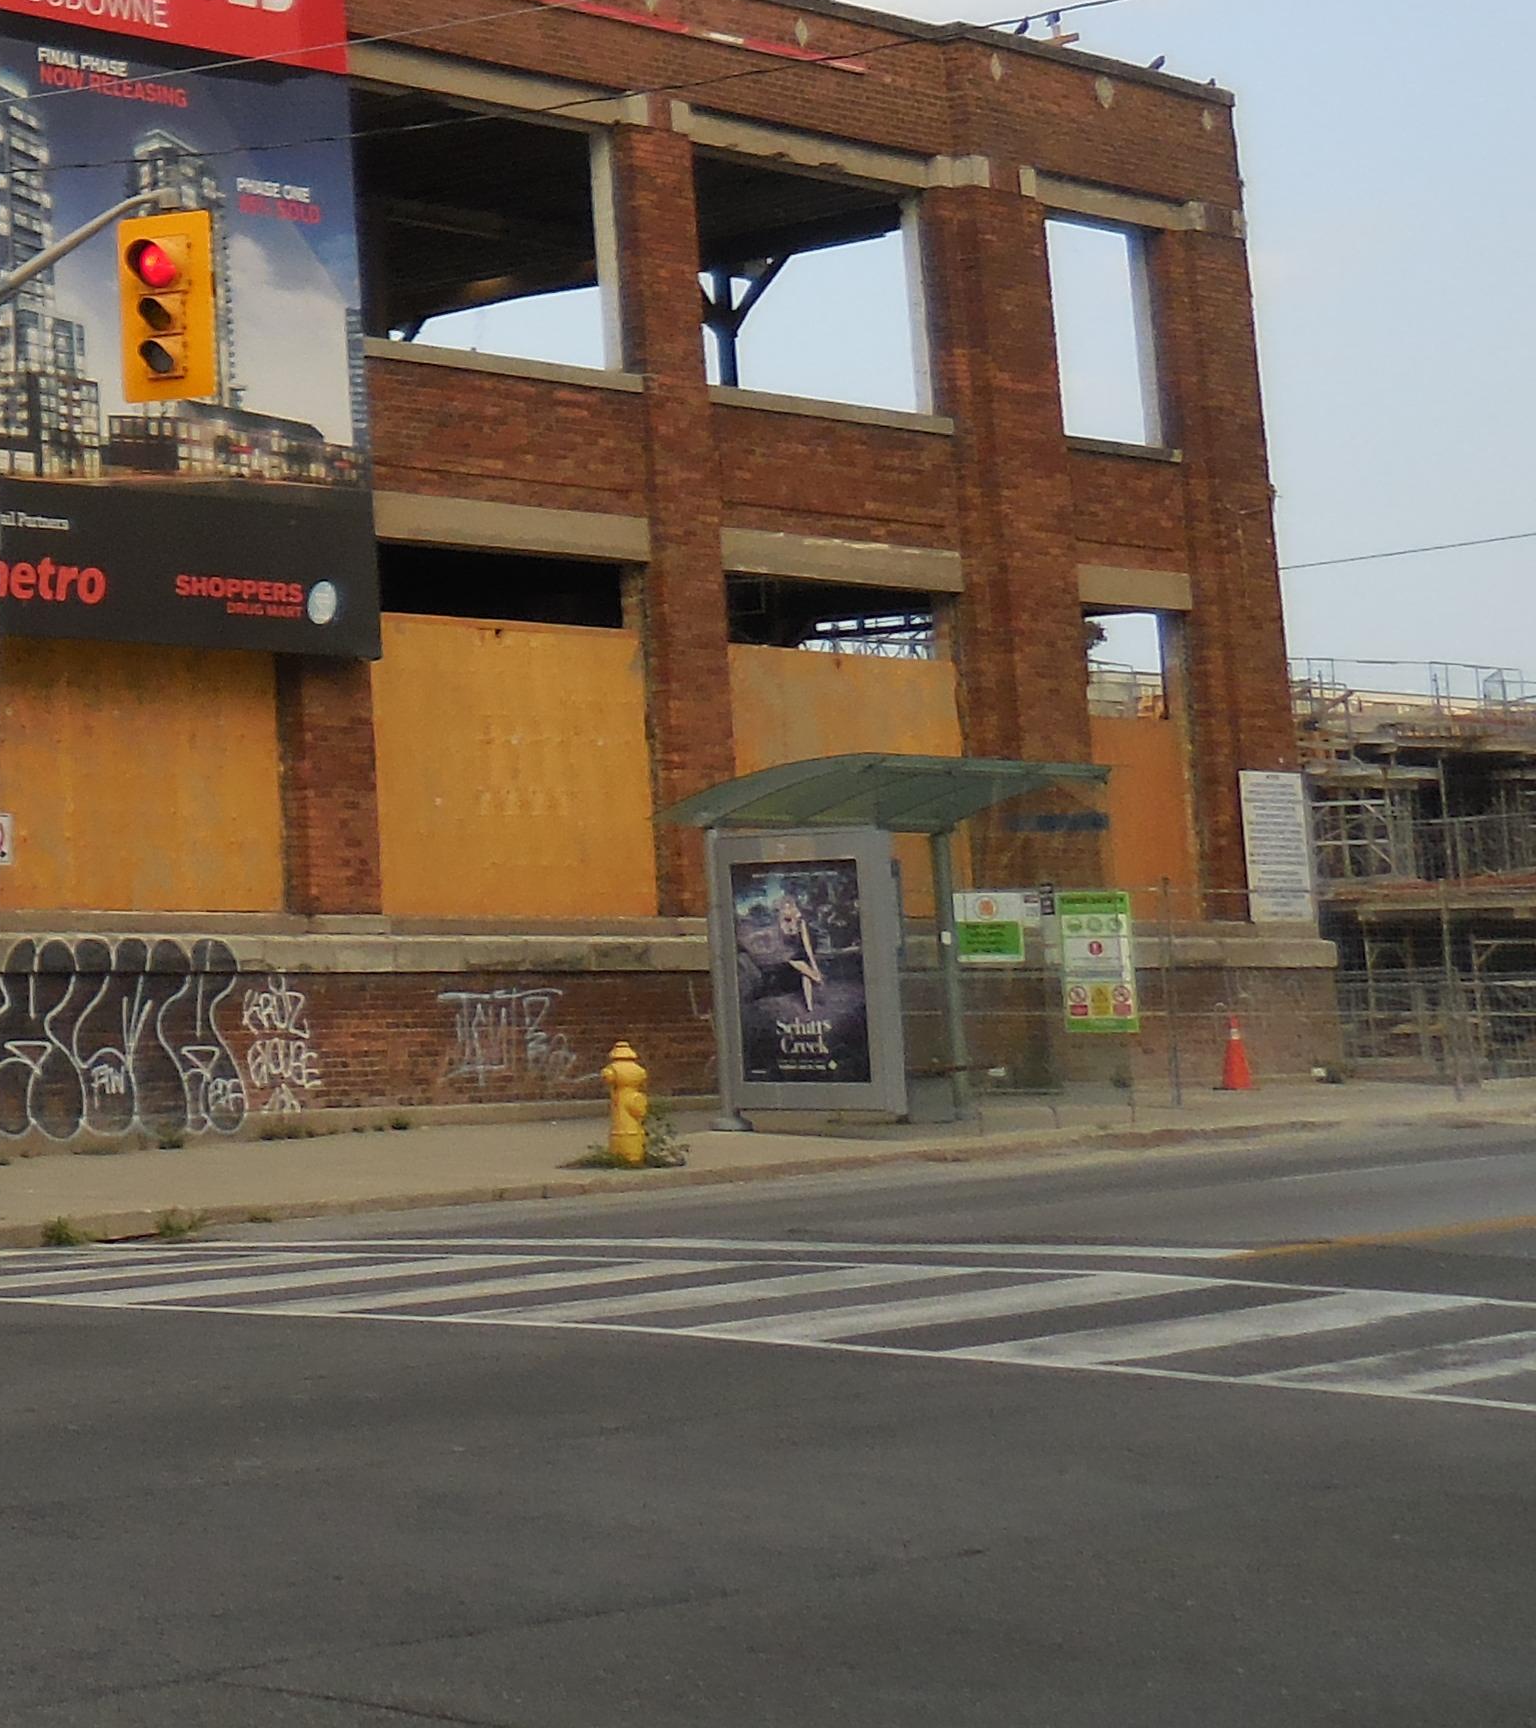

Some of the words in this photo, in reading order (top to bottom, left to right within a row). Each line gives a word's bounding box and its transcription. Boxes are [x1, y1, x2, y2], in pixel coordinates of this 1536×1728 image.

[37, 46, 79, 68] FINAL
[80, 54, 128, 77] PHASE
[39, 63, 88, 89] NOW
[89, 74, 189, 109] RELEASING
[175, 574, 304, 603] SHOPPERS
